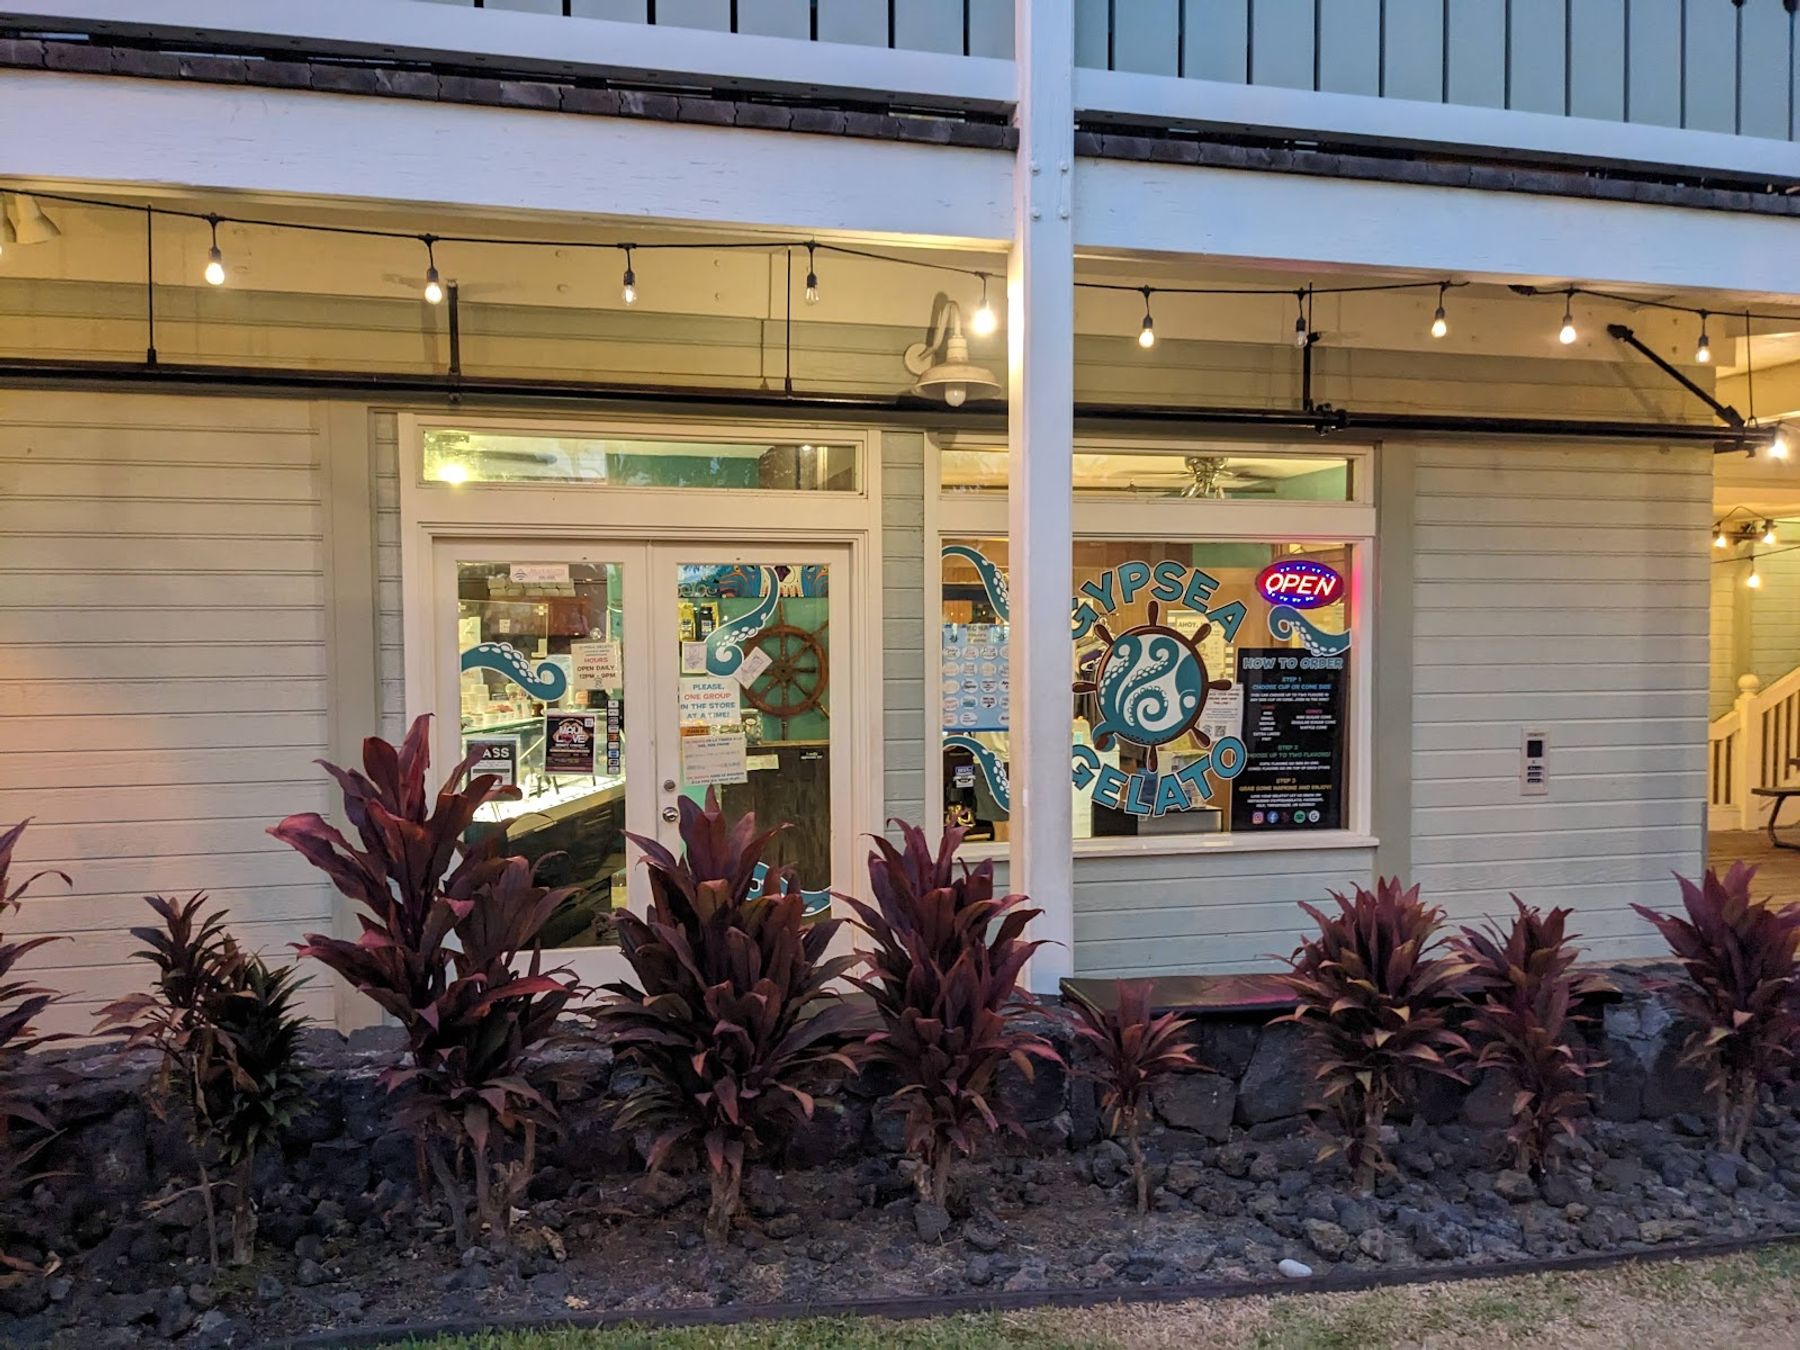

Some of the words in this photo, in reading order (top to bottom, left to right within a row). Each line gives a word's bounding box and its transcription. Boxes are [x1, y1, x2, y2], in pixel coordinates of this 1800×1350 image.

[1264, 573, 1337, 596] OPEN
[1072, 560, 1247, 643] GYPSEA
[1243, 657, 1276, 669] HOW
[1278, 657, 1298, 669] TO
[1300, 657, 1344, 670] ORDER
[482, 747, 510, 758] ASS
[1072, 736, 1247, 817] GELATO
